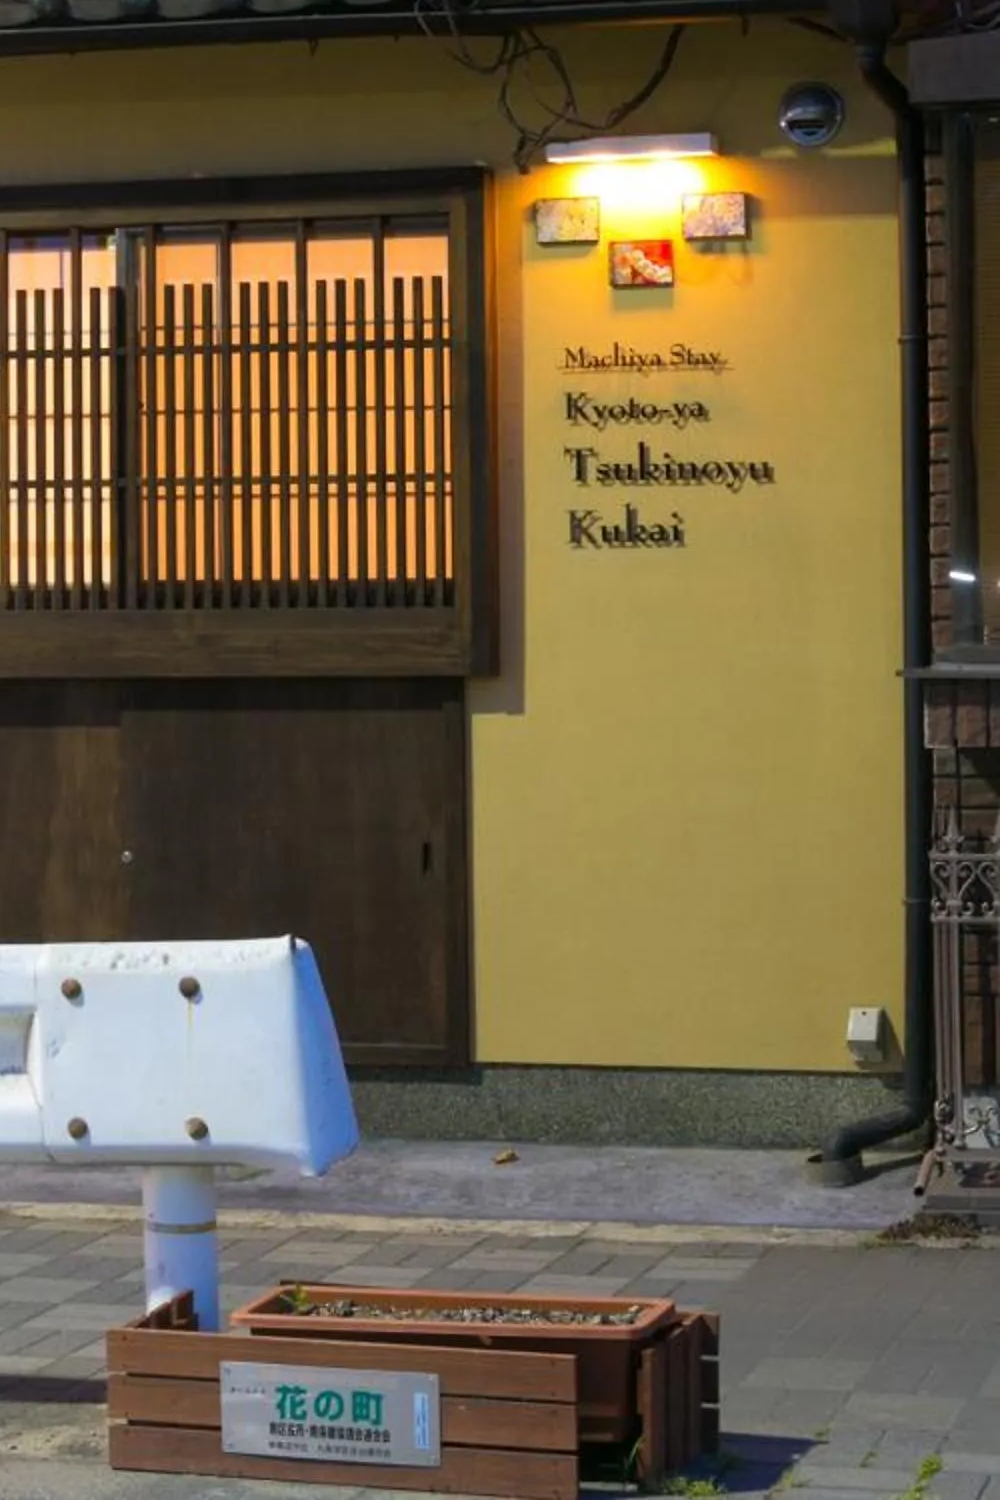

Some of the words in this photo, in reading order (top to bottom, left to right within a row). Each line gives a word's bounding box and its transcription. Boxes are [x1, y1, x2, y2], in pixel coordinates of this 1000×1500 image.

[563, 341, 662, 376] Machiya
[669, 343, 728, 375] Stay
[564, 391, 710, 430] Kyoto-ya
[563, 440, 776, 494] Tsukinoyu
[566, 502, 688, 549] Kukai
[275, 1384, 385, 1426] 花の町
